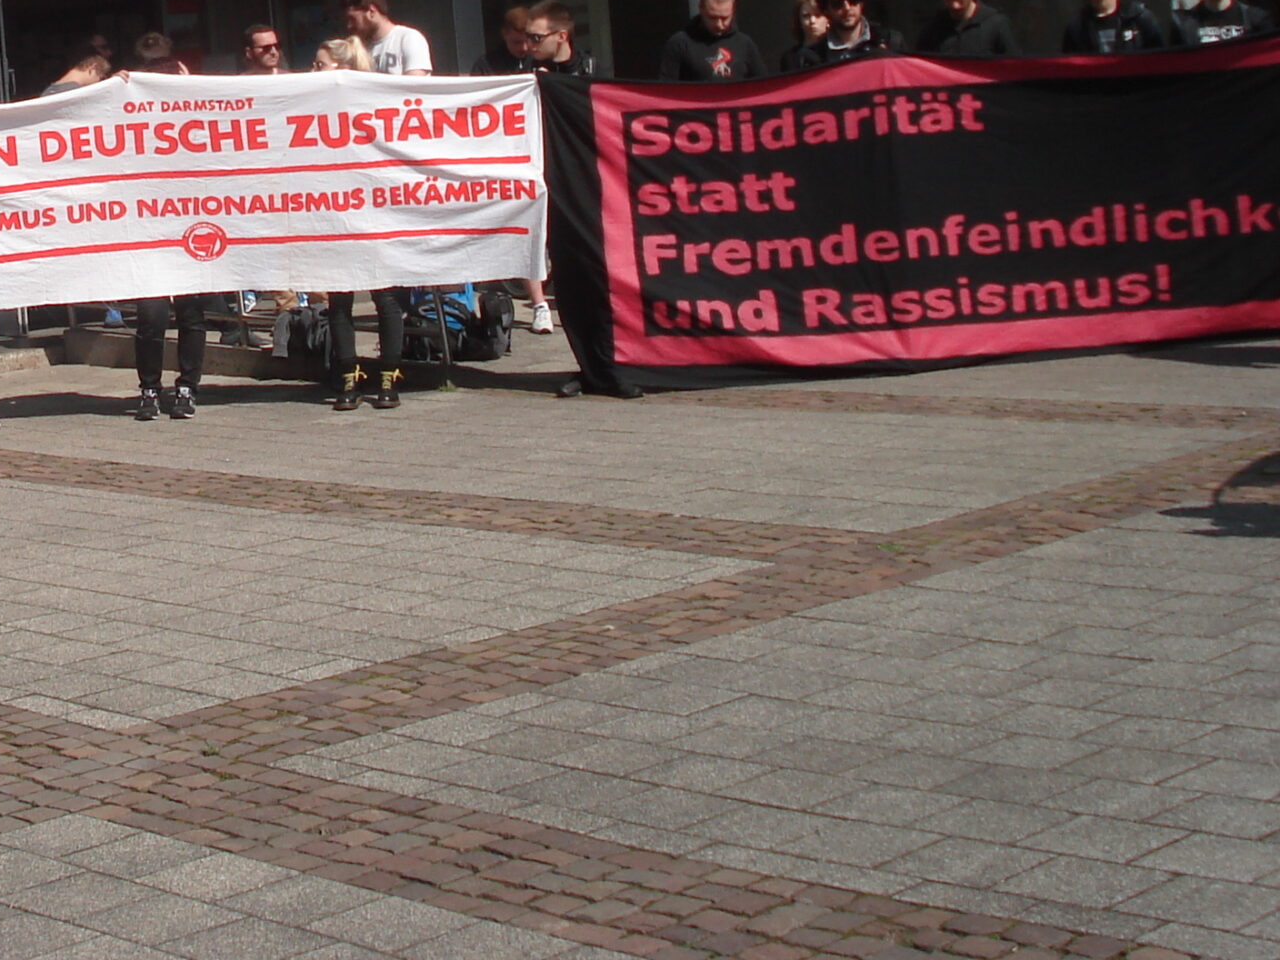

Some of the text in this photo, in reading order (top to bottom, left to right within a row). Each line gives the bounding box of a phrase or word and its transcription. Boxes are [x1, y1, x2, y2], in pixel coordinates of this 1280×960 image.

[39, 118, 269, 163] DEUTSCHE
[287, 98, 526, 149] ZUSTÄNDE
[123, 98, 255, 114] OAT DARMSTADT
[630, 92, 985, 157] Solidarität
[67, 201, 127, 224] UND
[137, 188, 365, 218] NATIONALISMUS
[372, 178, 536, 208] BEKÄMPFEN
[637, 172, 796, 216] statt
[642, 194, 1280, 276] Fremdenfeindlichk
[653, 264, 1172, 332] und Rassismus!
